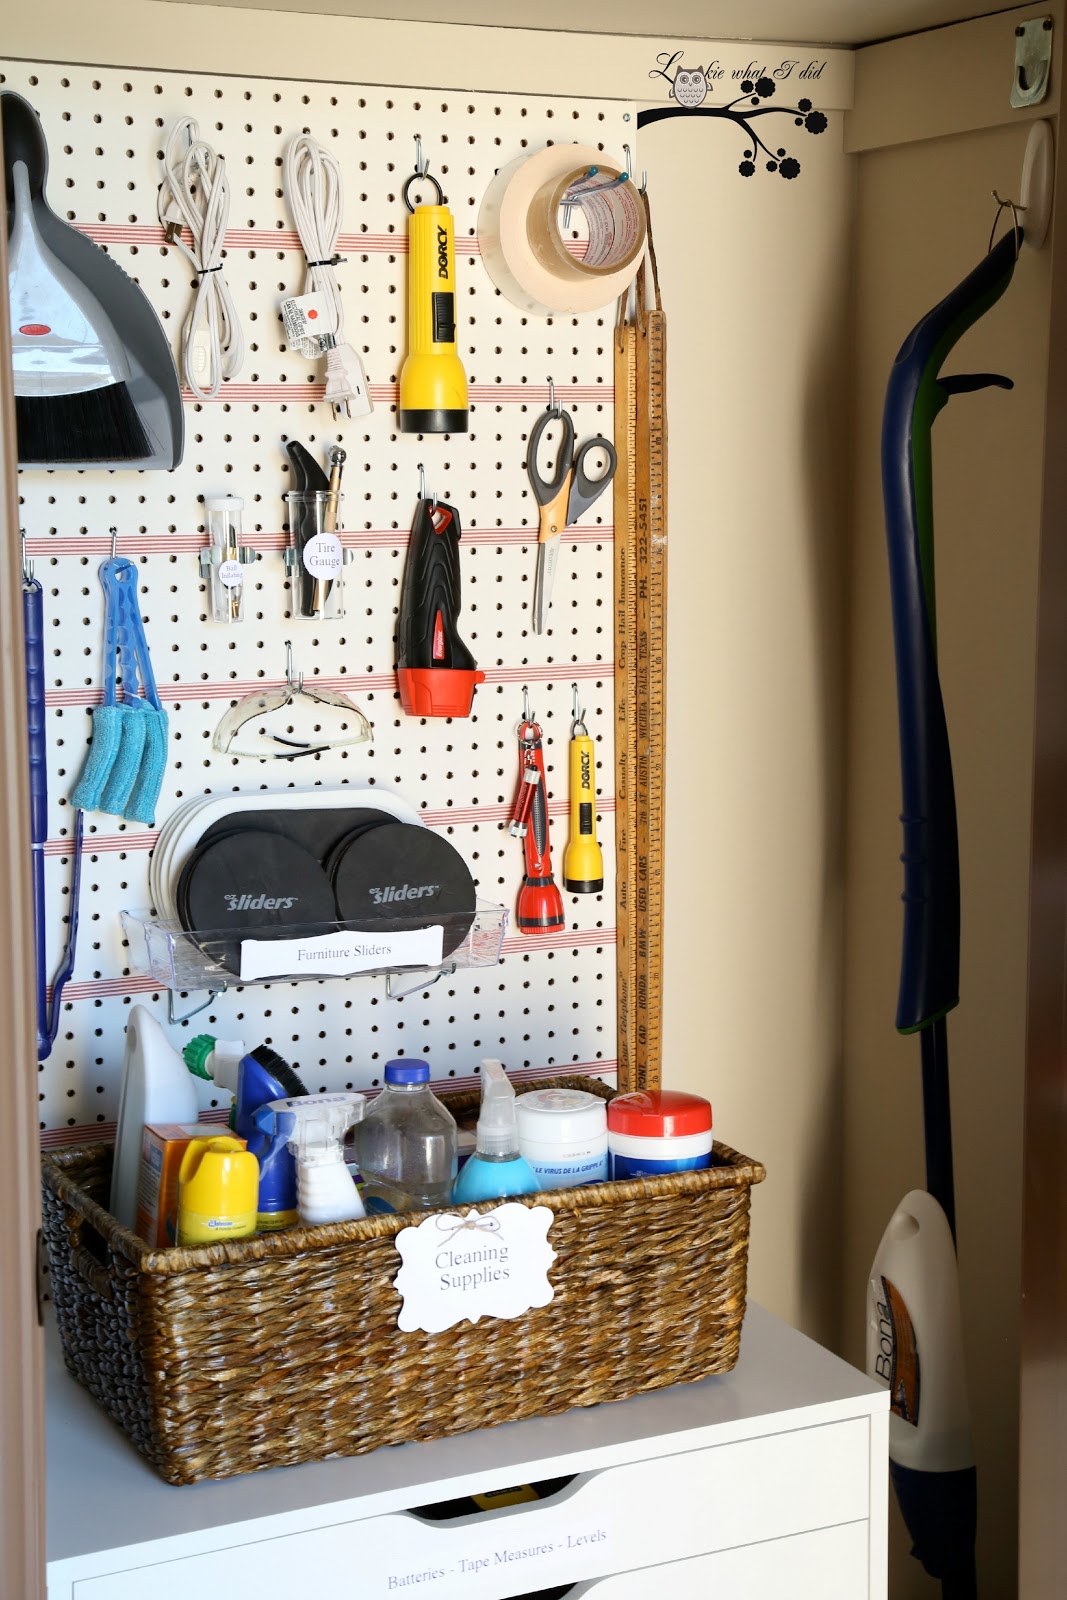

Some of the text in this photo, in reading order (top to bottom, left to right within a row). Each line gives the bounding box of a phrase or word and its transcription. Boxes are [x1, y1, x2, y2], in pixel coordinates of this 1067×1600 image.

[437, 224, 448, 279] DORCY
[638, 498, 647, 564] 322-5451
[316, 543, 336, 552] Tire
[309, 556, 340, 568] Gauge
[618, 548, 626, 607] Insurance
[639, 576, 648, 599] PH.
[618, 610, 626, 635] Hail
[618, 641, 627, 669] Crop
[639, 631, 647, 660] TEXAS
[618, 699, 626, 722] Life
[639, 701, 647, 739] WICHITA
[581, 750, 590, 790] DORCY
[618, 752, 627, 800] Casualty
[639, 755, 647, 787] AUSTIN
[639, 793, 647, 805] AT
[618, 829, 626, 853] Fire
[638, 856, 646, 881] CARS
[619, 881, 627, 911] Auto
[638, 887, 646, 912] USED
[298, 945, 392, 961] Furniture Sliders
[638, 929, 646, 958] BMW
[638, 975, 646, 1009] HONDA
[638, 1025, 646, 1045] CAD
[620, 1041, 628, 1068] Your
[581, 1162, 598, 1171] GRIPPE
[435, 1245, 508, 1269] Cleaning
[440, 1266, 510, 1291] Supplies
[875, 1302, 892, 1381] Bona
[388, 1567, 445, 1590] Batteries
[458, 1556, 490, 1573] Tape
[494, 1542, 554, 1565] Measures
[567, 1529, 607, 1549] Levels
